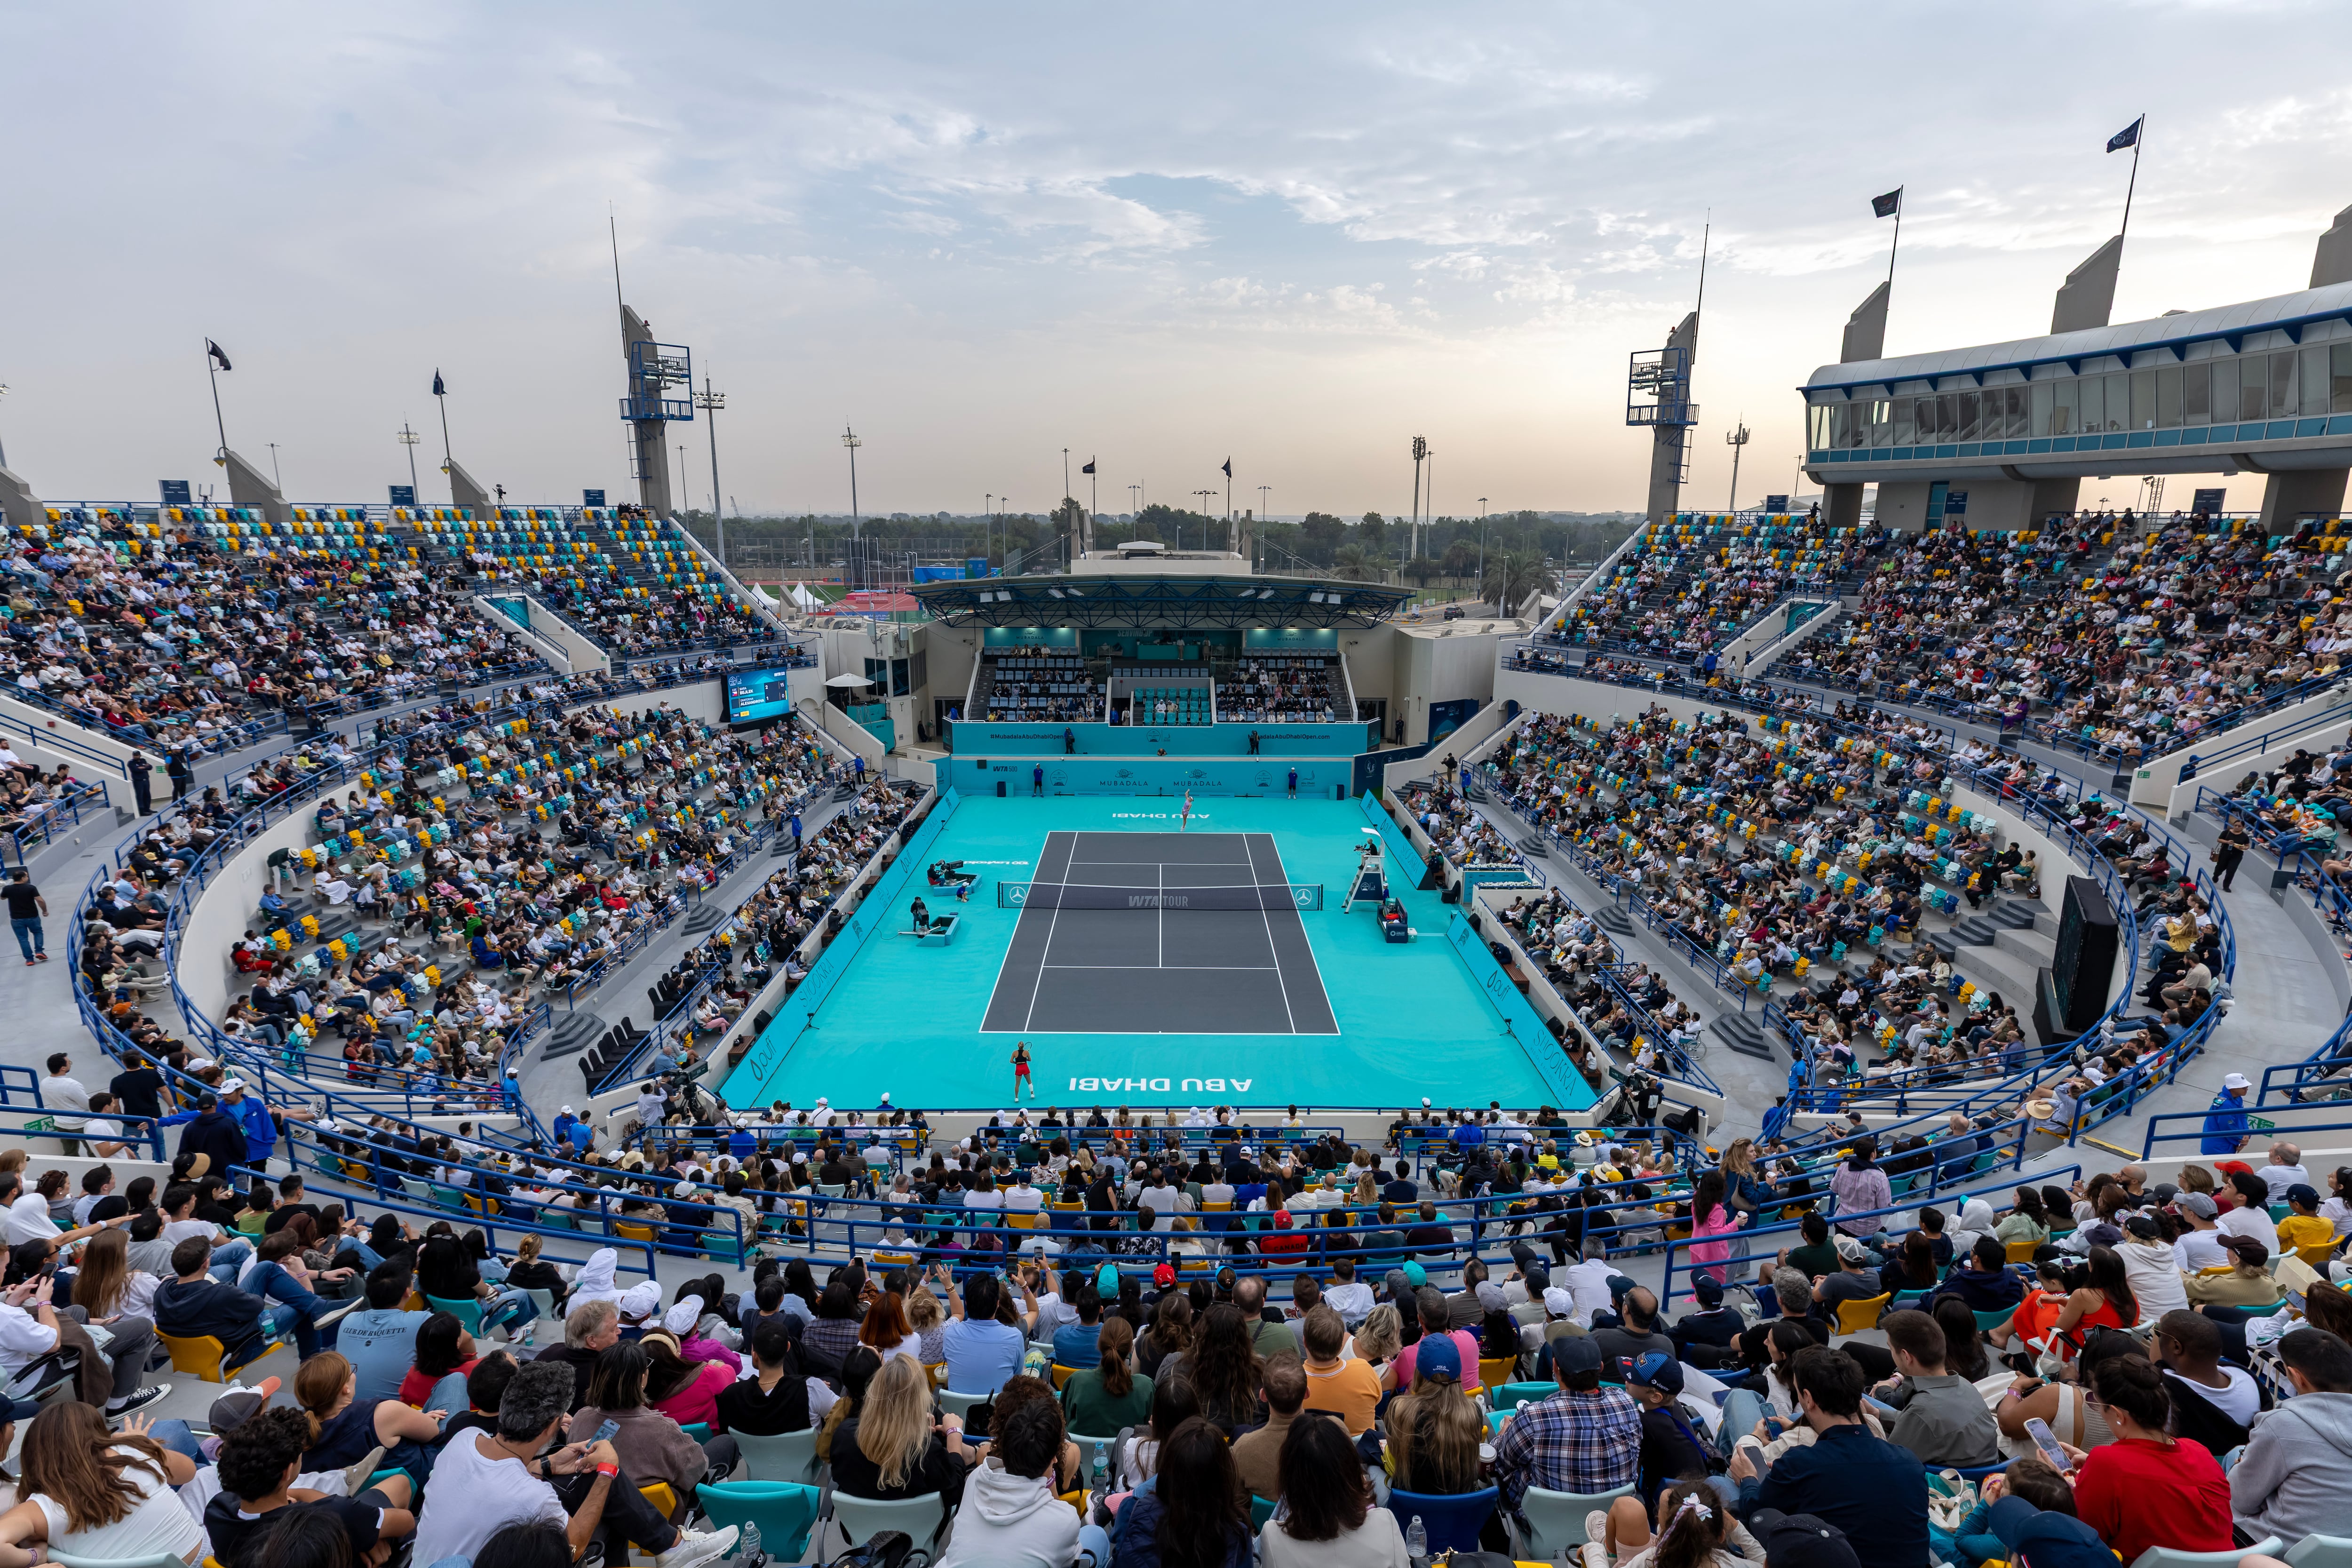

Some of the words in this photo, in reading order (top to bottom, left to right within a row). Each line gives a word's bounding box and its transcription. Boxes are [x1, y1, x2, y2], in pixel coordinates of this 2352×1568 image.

[1128, 895, 1159, 907] WTA
[1162, 896, 1188, 907] TOUR
[798, 958, 834, 1007] SHOOKRA
[1534, 1029, 1577, 1096] SHOOKRA
[1069, 1078, 1170, 1091] DHABI
[1181, 1078, 1253, 1091] ABU
[1274, 1243, 1304, 1252] CANADA
[368, 1327, 407, 1337] RAQUETTE
[1657, 1382, 1670, 1392] viaplay
